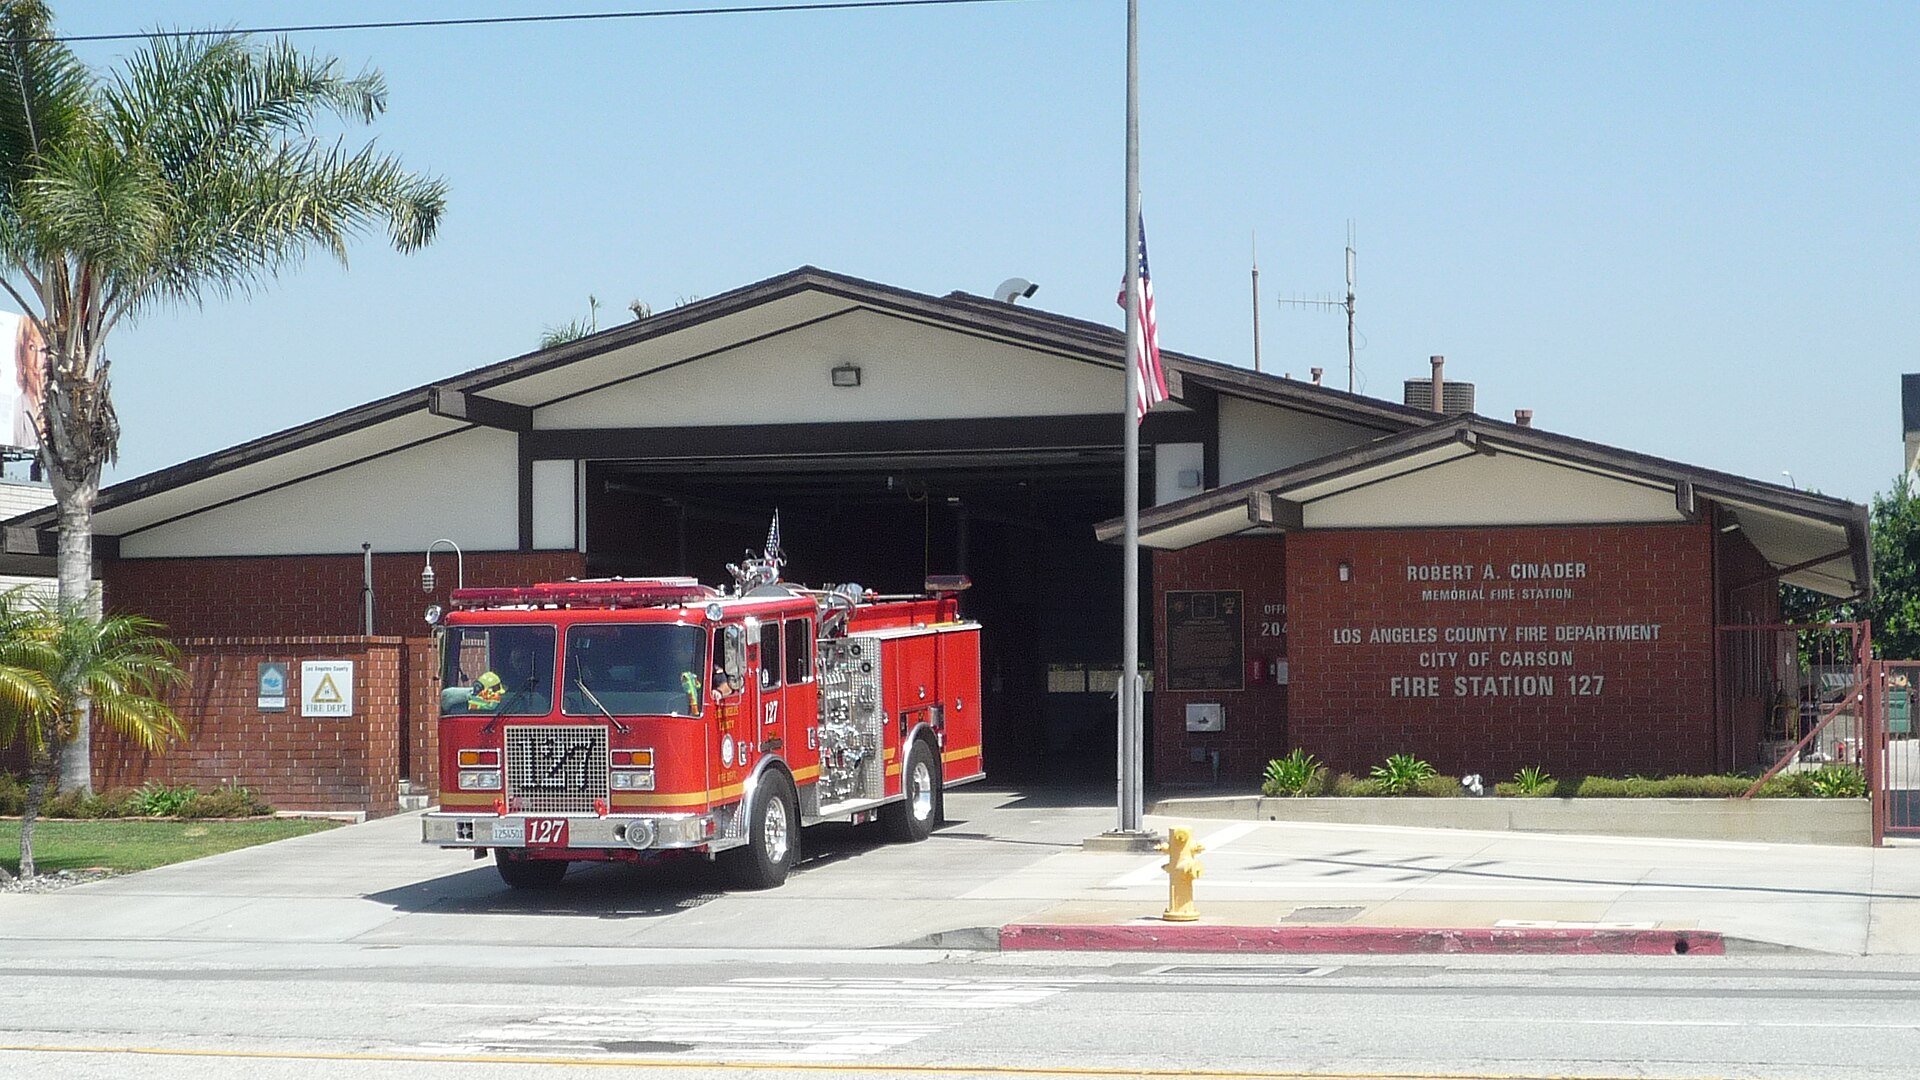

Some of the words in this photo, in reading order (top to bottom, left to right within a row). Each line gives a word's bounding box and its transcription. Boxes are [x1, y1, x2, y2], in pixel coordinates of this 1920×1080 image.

[1407, 564, 1473, 581] ROBERT
[1483, 564, 1500, 580] A.
[1510, 562, 1586, 579] CINADER
[1422, 588, 1485, 601] MEMORIAL
[1490, 588, 1515, 600] FIRE
[1522, 587, 1573, 600] STATION
[1264, 604, 1288, 614] OFFI
[1333, 628, 1361, 644] LOS
[1369, 627, 1437, 644] ANGELES
[1445, 626, 1508, 643] COUNTY
[1515, 625, 1548, 642] FIRE
[1555, 624, 1662, 641] DEPARTMENT
[1419, 652, 1458, 668] CITY
[1468, 651, 1490, 667] OF
[1500, 650, 1573, 667] CARSON
[1390, 676, 1440, 697] FIRE
[1454, 675, 1553, 697] STATION
[1568, 675, 1605, 696] 127
[305, 704, 324, 713] FIRE
[764, 700, 778, 725] 127
[528, 820, 565, 843] 127
